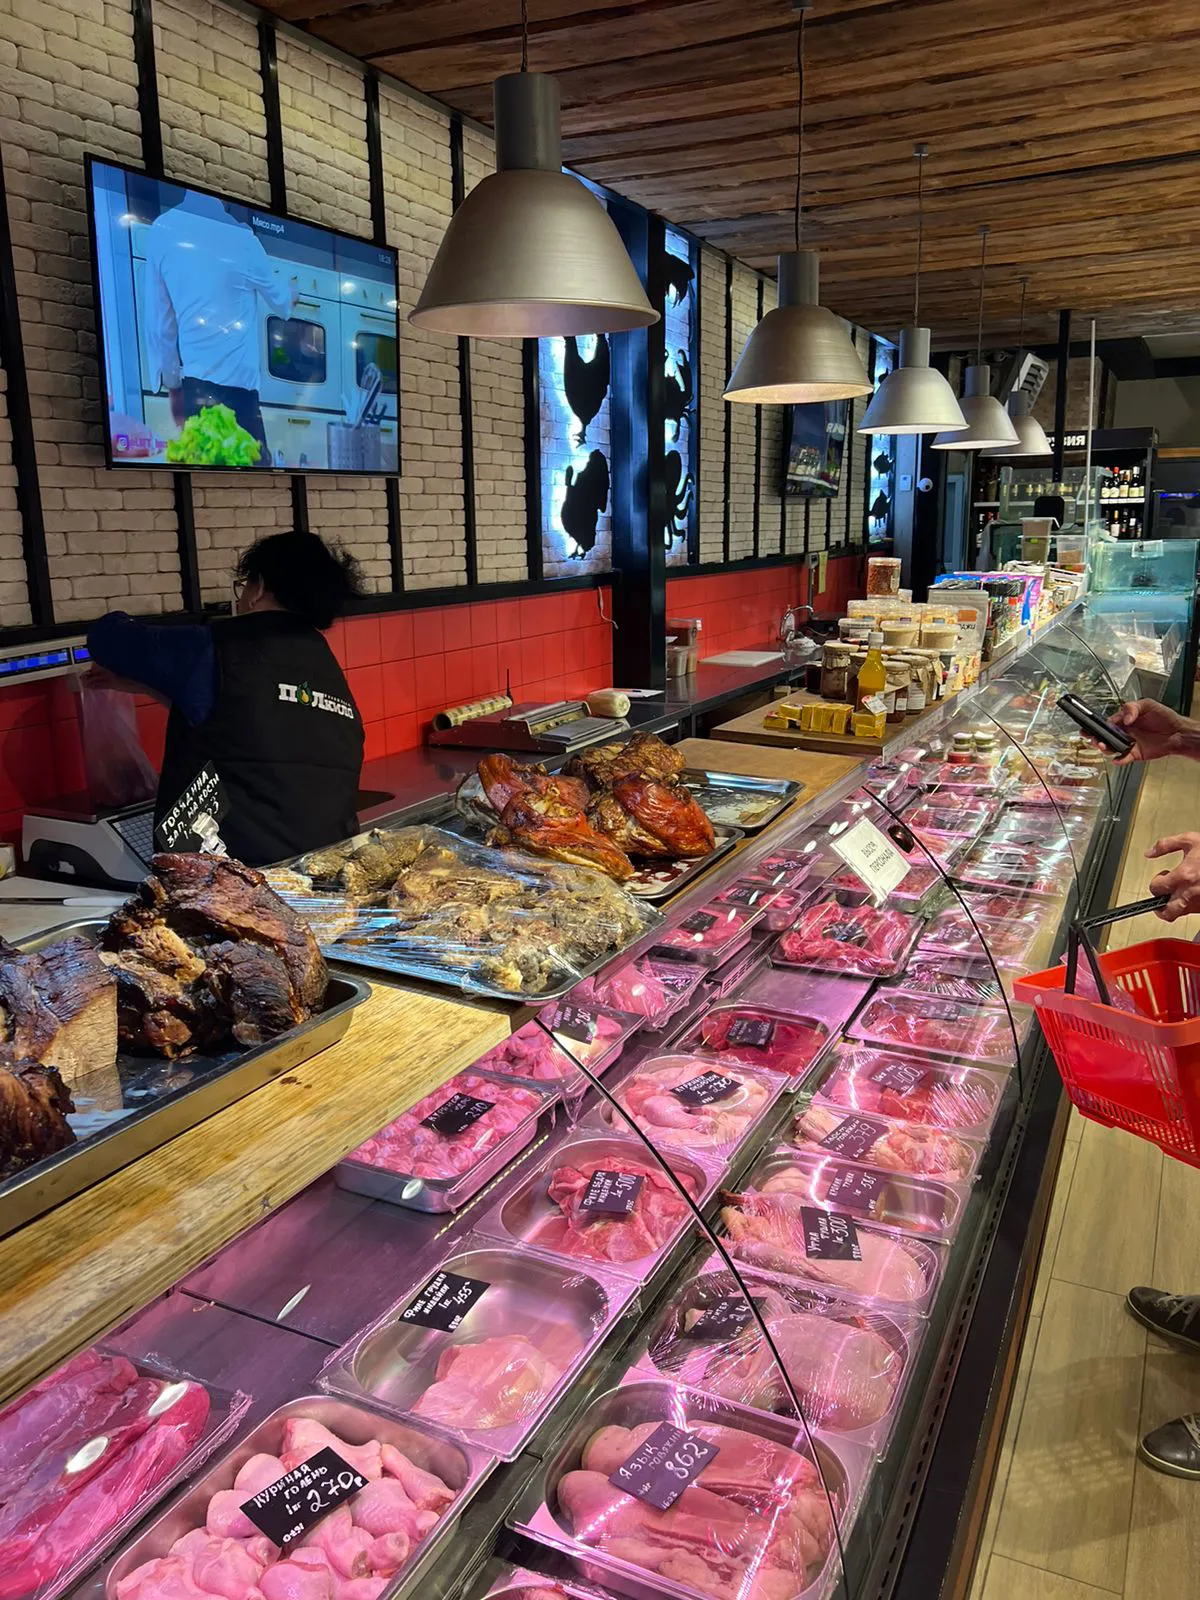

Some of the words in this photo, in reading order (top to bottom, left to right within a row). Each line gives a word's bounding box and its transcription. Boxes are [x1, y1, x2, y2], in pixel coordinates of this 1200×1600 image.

[161, 770, 209, 835] ГОВЯДИНА
[187, 801, 199, 818] НА
[198, 773, 220, 804] КОСТИ
[869, 848, 895, 873] ПЕРСОНАЛА
[465, 1102, 489, 1118] 270
[849, 1122, 877, 1146] 379
[423, 1283, 450, 1314] ИНДЕЙКИ
[424, 1273, 447, 1297] ГРУДКИ
[253, 1463, 311, 1508] КУРИНАЯ
[284, 1466, 328, 1500] ГОЛЕНЬ
